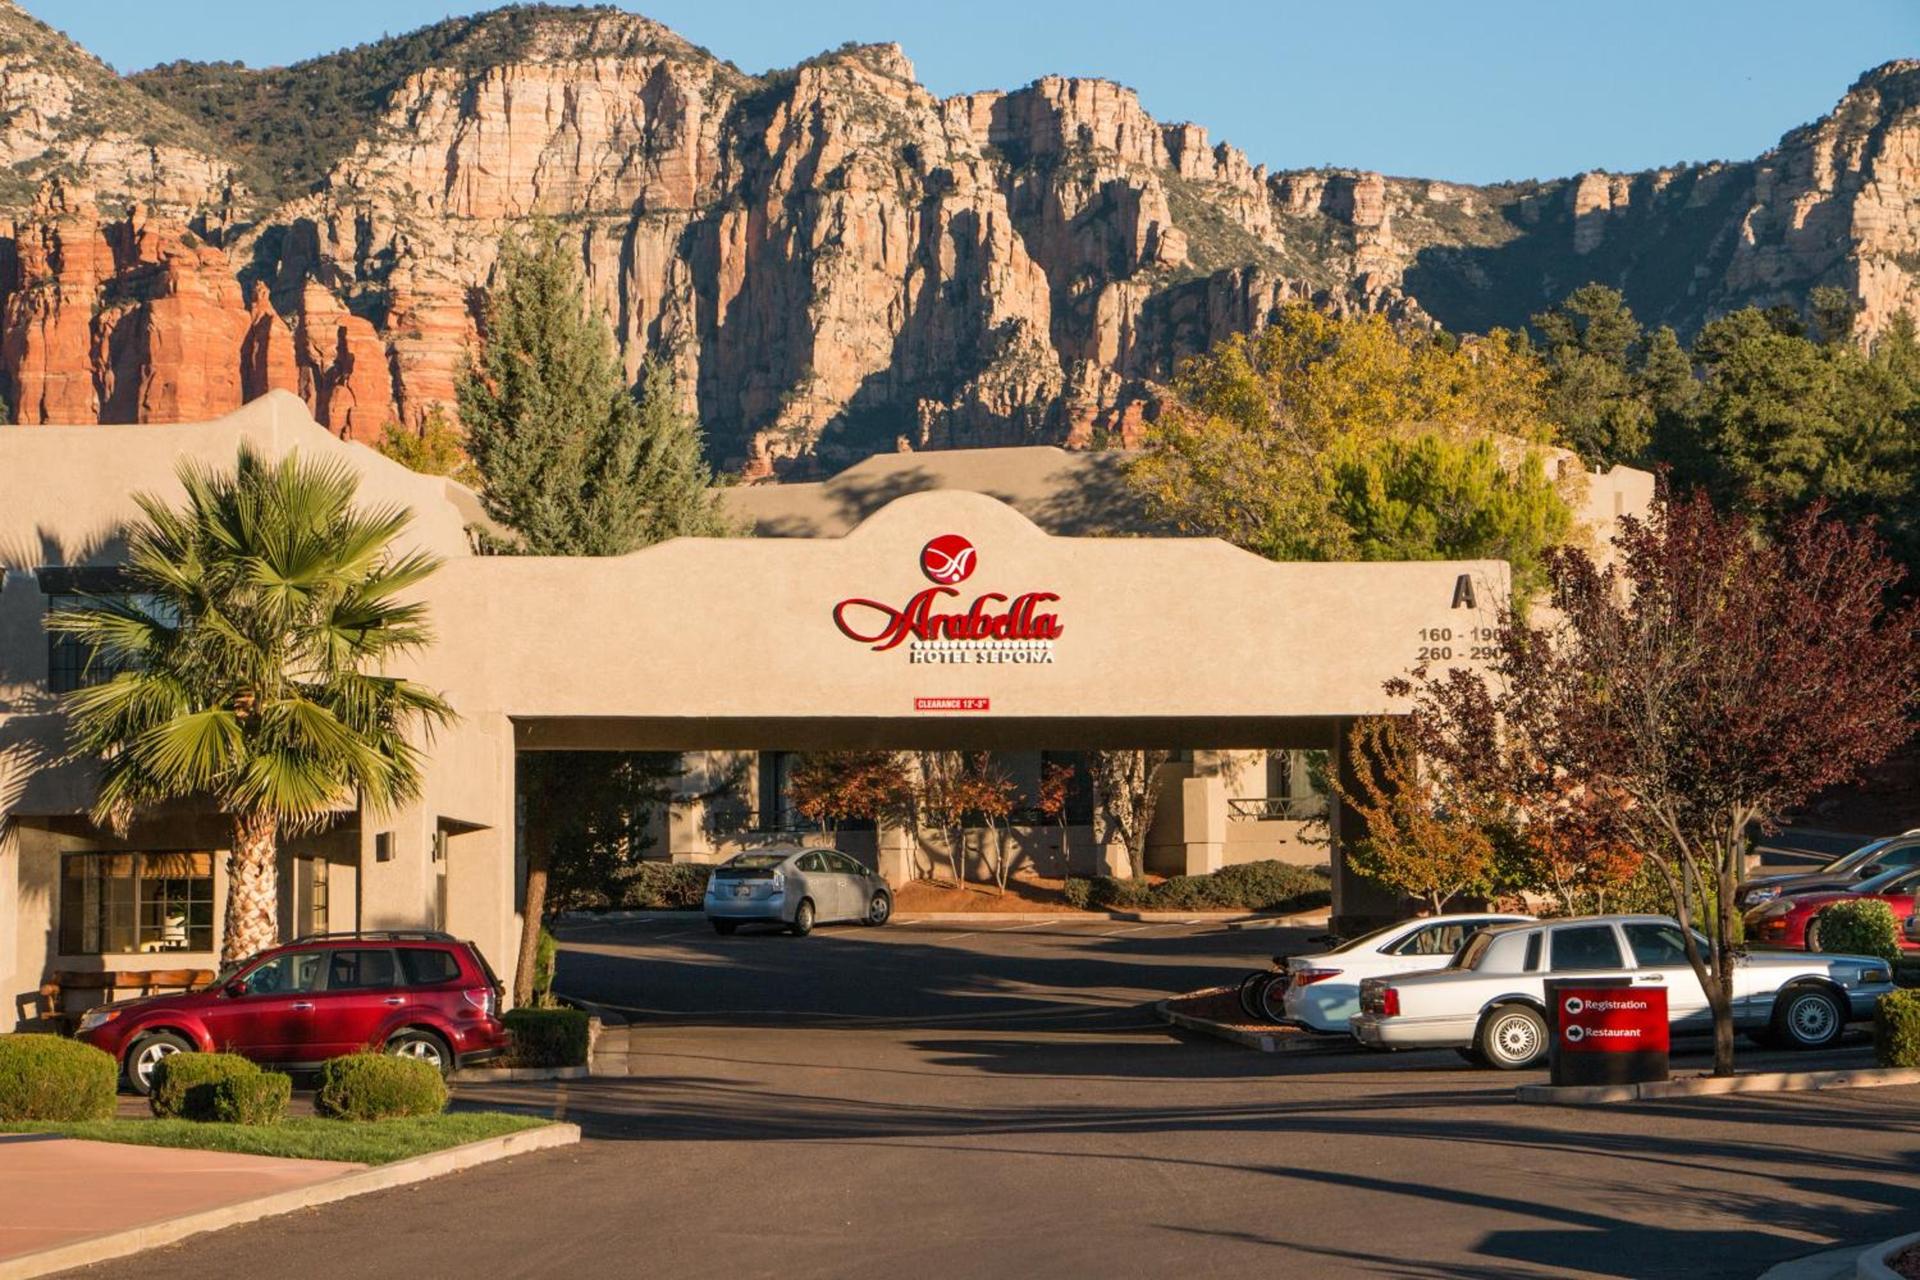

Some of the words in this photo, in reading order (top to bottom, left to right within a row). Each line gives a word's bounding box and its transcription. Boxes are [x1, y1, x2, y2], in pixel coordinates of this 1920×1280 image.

[1451, 574, 1477, 609] A
[833, 586, 1063, 651] Arabella
[1419, 628, 1452, 642] 160
[910, 651, 972, 664] HOTEL
[976, 651, 1054, 664] SEDONA
[1418, 647, 1452, 660] 260
[1470, 647, 1503, 660] 290
[918, 699, 961, 709] CLEARANCE
[1585, 1000, 1647, 1010] Registration
[1585, 1028, 1641, 1037] Restaurant
